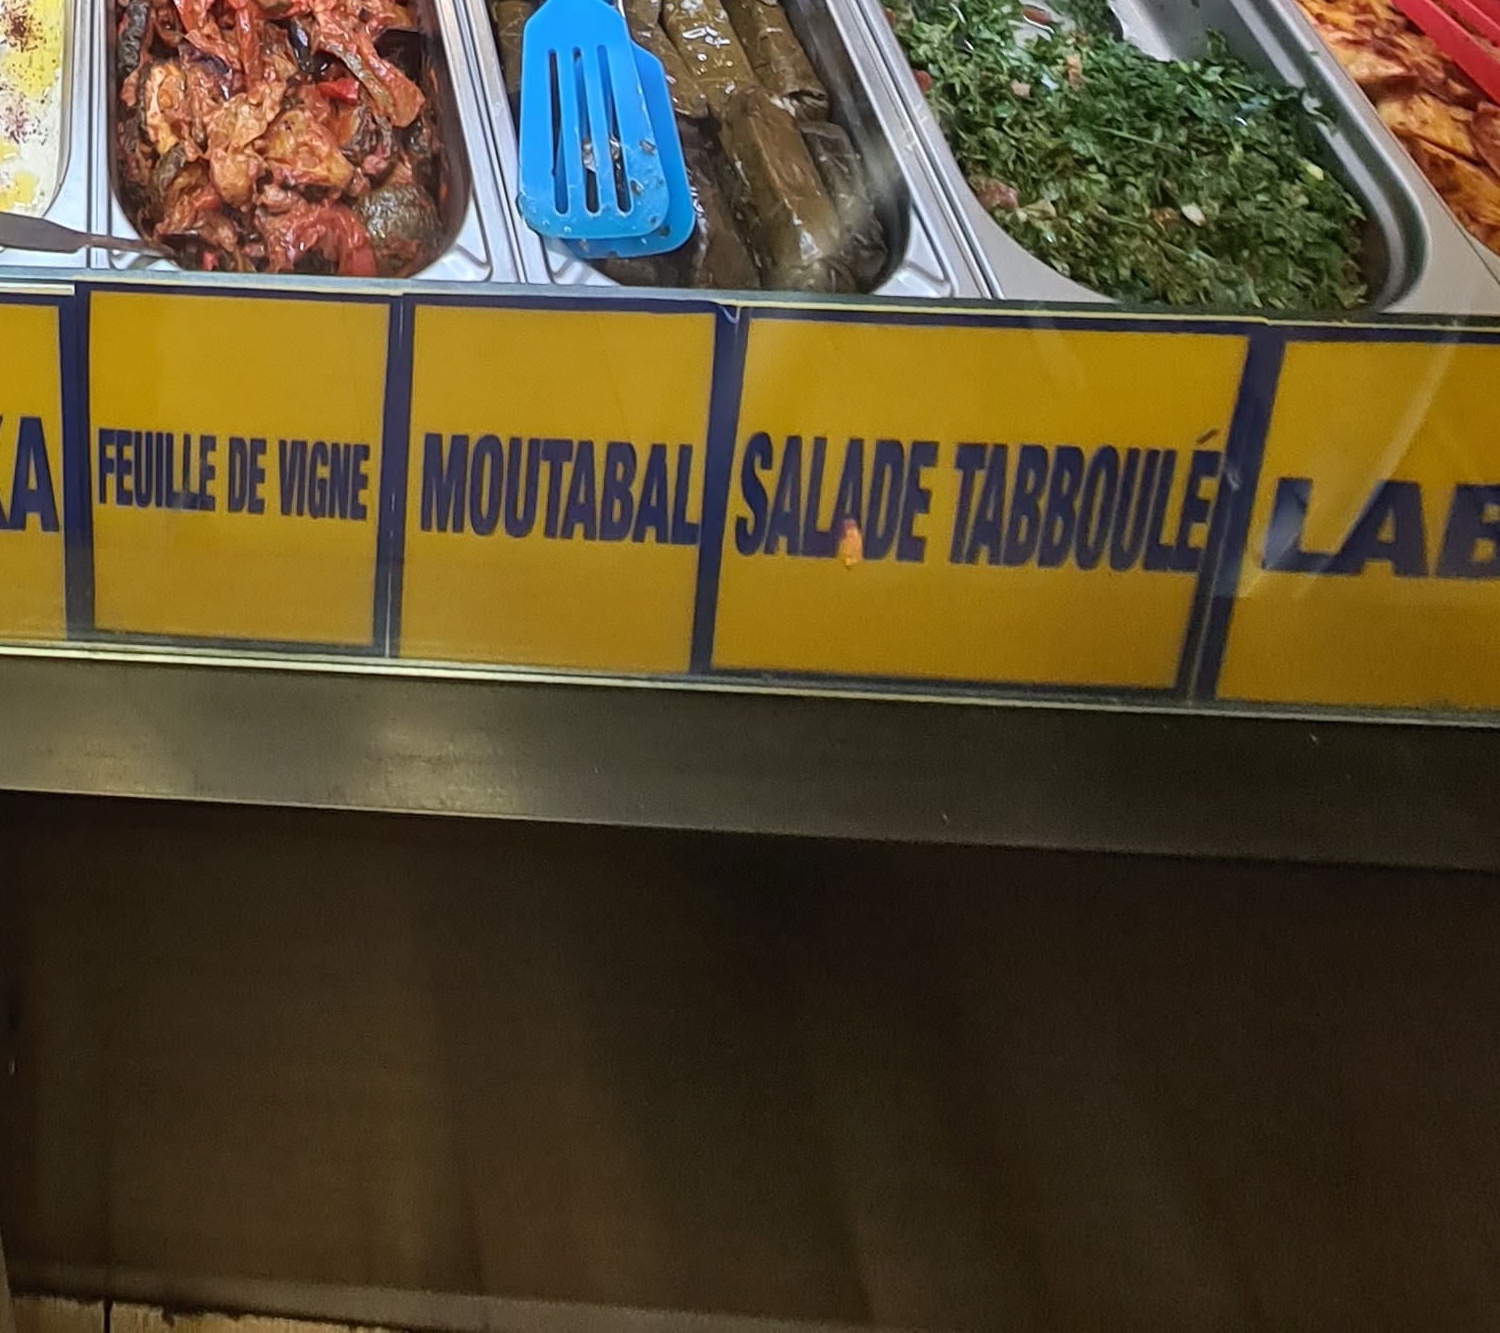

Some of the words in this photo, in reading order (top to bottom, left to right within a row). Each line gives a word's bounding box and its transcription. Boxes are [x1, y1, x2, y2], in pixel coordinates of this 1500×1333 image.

[98, 427, 217, 512] FEUILLE
[227, 436, 266, 515] DE
[278, 439, 371, 521] VIGNE
[420, 433, 701, 546] MOUTABAL
[734, 432, 940, 564] SALADE
[949, 428, 1225, 573] TABBOULÉ
